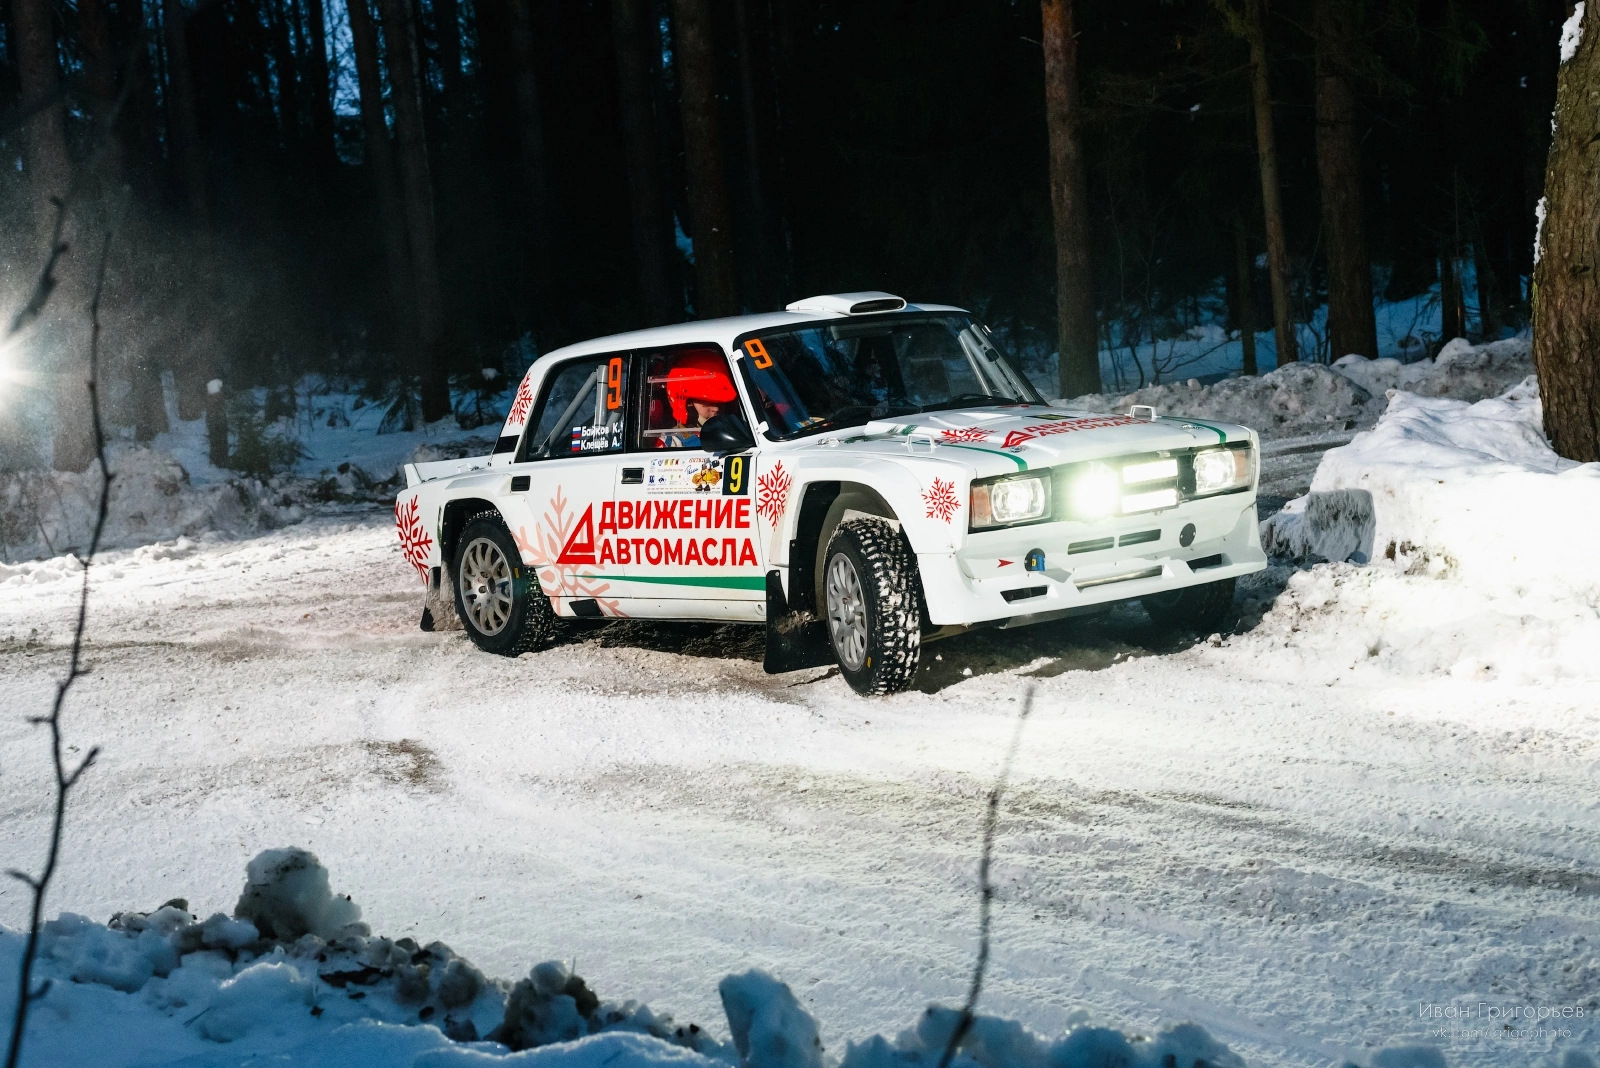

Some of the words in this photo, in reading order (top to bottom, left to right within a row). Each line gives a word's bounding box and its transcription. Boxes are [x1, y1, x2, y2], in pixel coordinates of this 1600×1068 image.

[743, 338, 773, 370] 9
[606, 357, 623, 410] 9
[581, 425, 610, 437] Байков
[612, 422, 621, 434] К.
[1038, 418, 1157, 437] АВТОМАСЛ
[580, 437, 609, 451] Клещёв
[611, 436, 620, 448] А.
[729, 456, 743, 493] 9
[598, 498, 752, 535] ДВИЖЕНИЕ
[599, 537, 758, 567] АВТОМАСЛА
